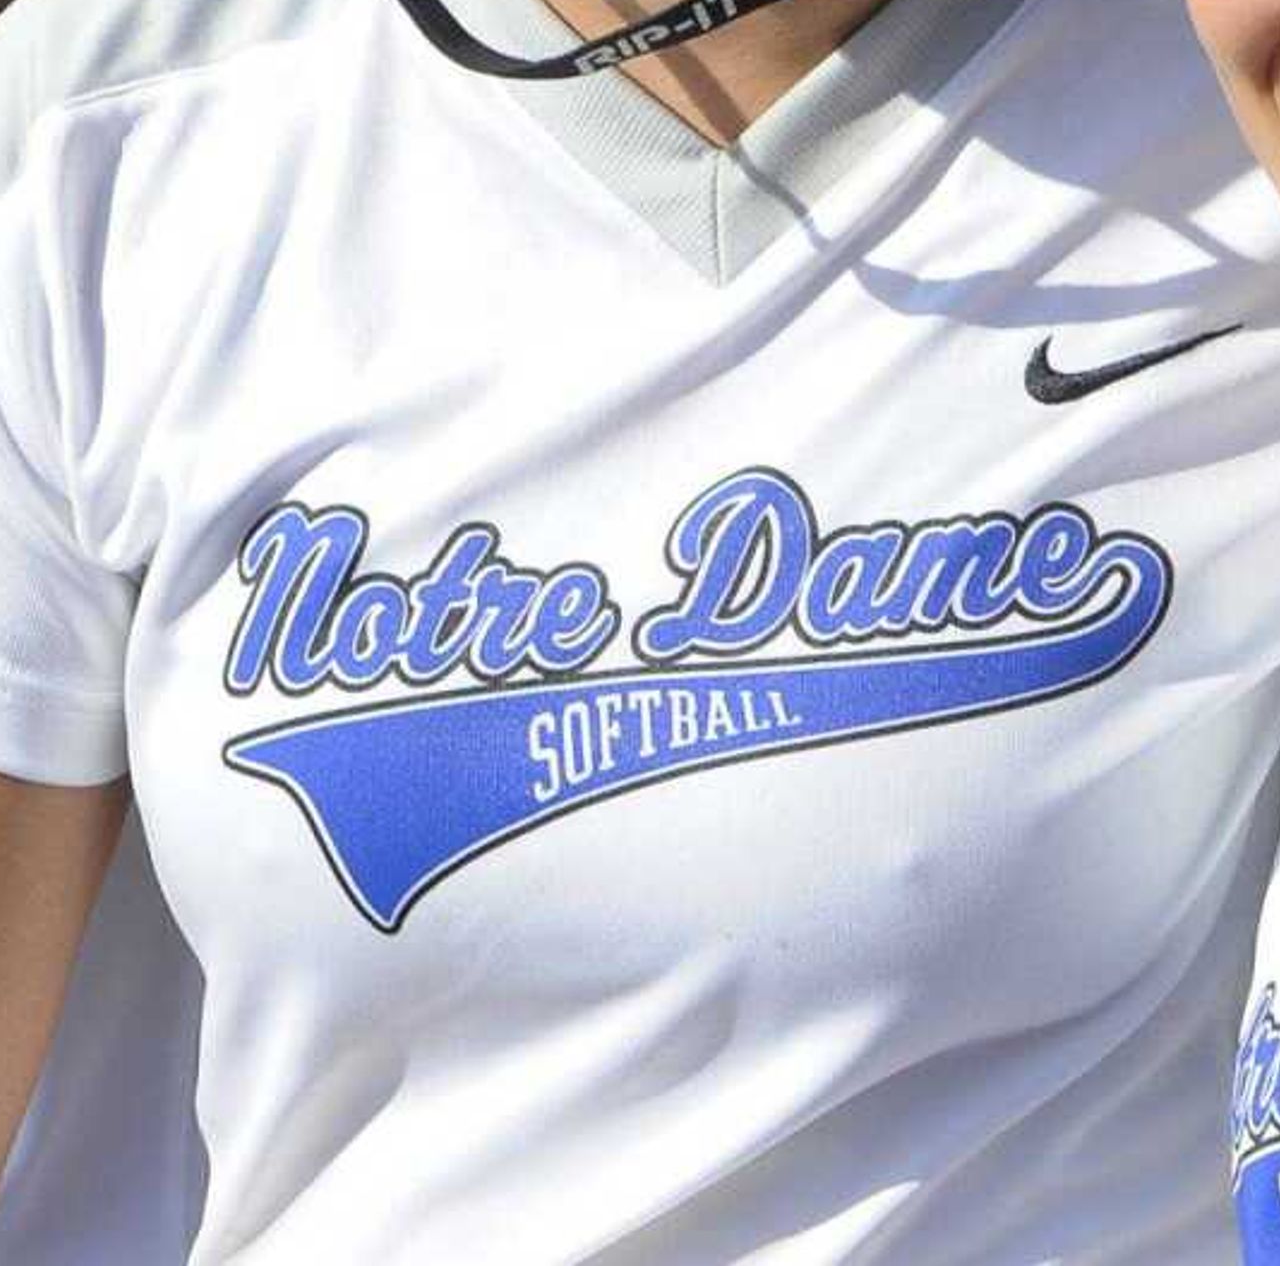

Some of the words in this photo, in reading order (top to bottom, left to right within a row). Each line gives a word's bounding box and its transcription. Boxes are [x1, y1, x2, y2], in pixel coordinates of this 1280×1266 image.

[224, 501, 622, 696] Notre
[633, 466, 1102, 669] Dame
[528, 689, 803, 803] SOFTBALL
